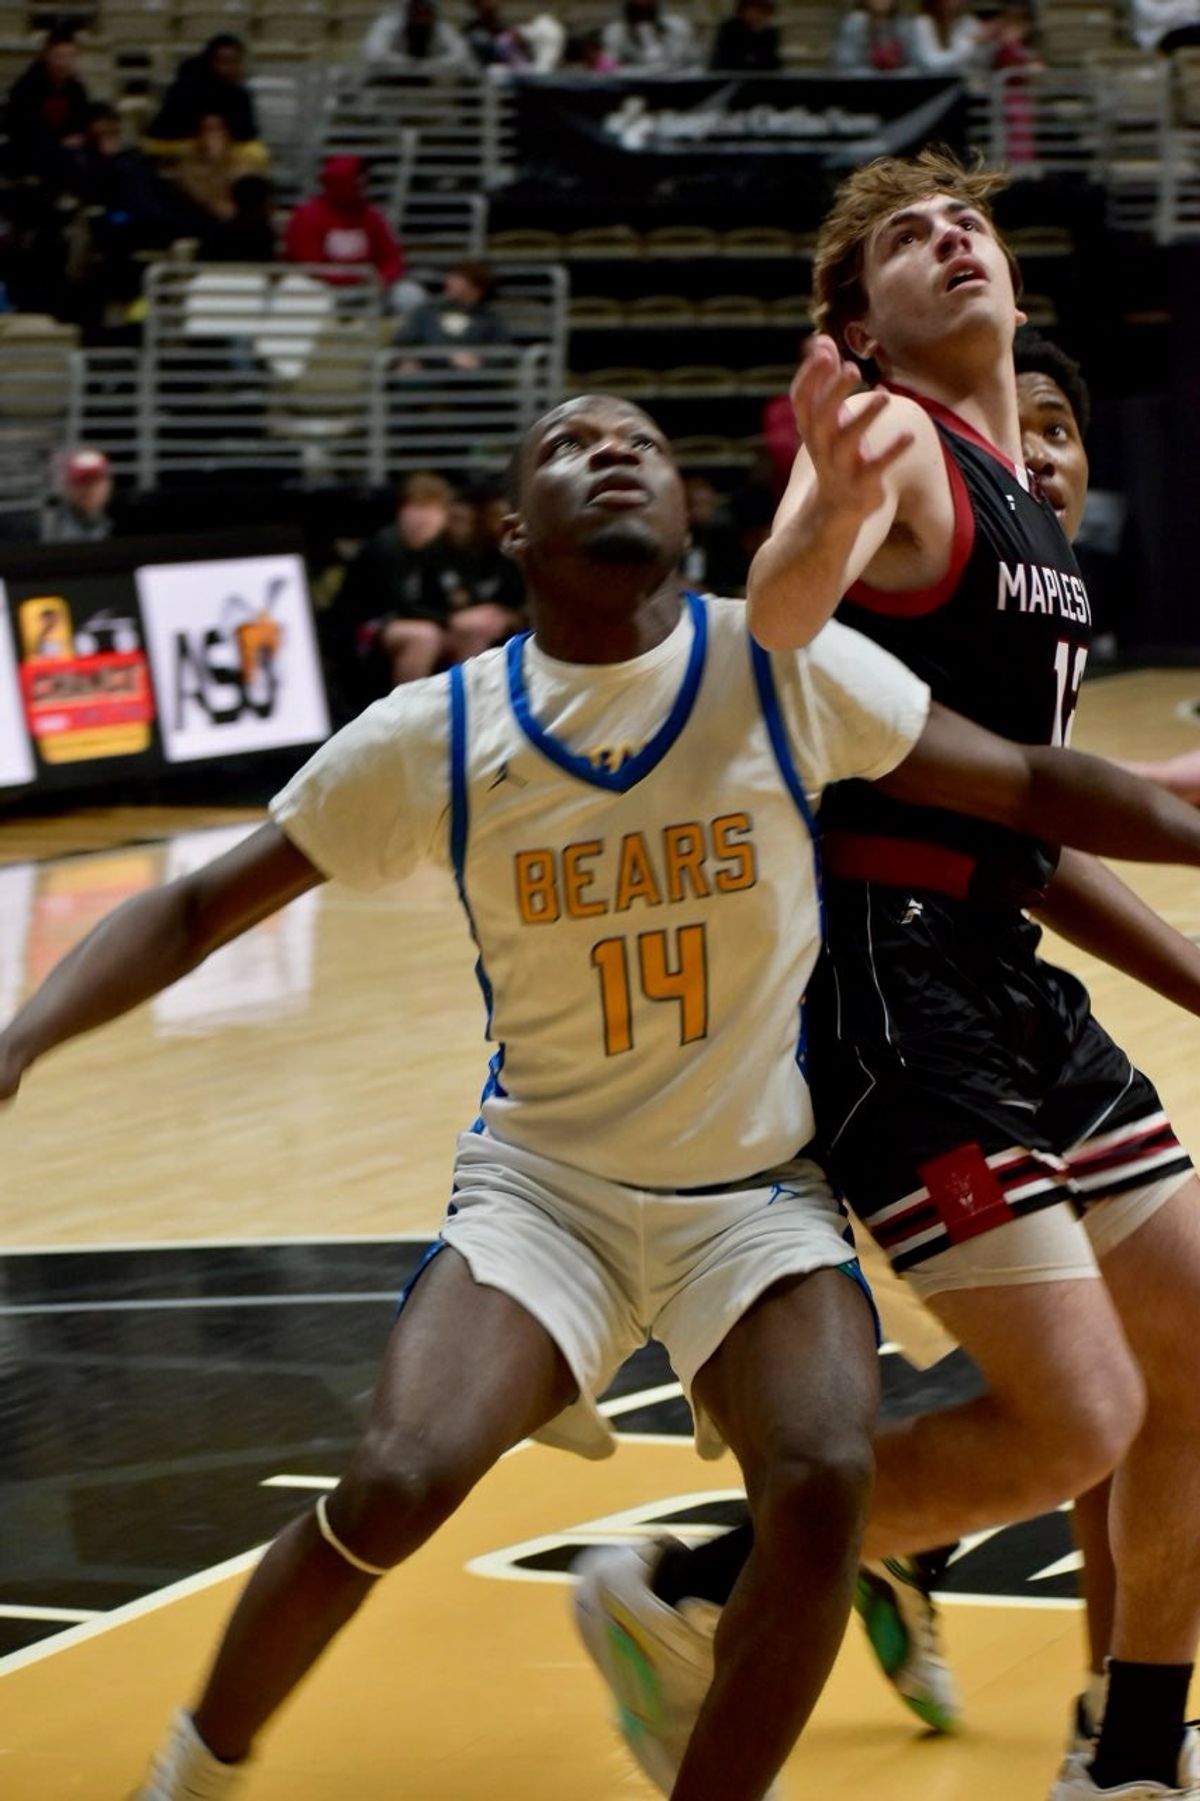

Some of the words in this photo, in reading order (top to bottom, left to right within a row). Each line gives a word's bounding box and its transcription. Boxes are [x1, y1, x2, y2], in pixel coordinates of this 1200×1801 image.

[997, 561, 1092, 627] MAPLES
[514, 811, 757, 926] BEARS
[590, 922, 708, 1057] 14
